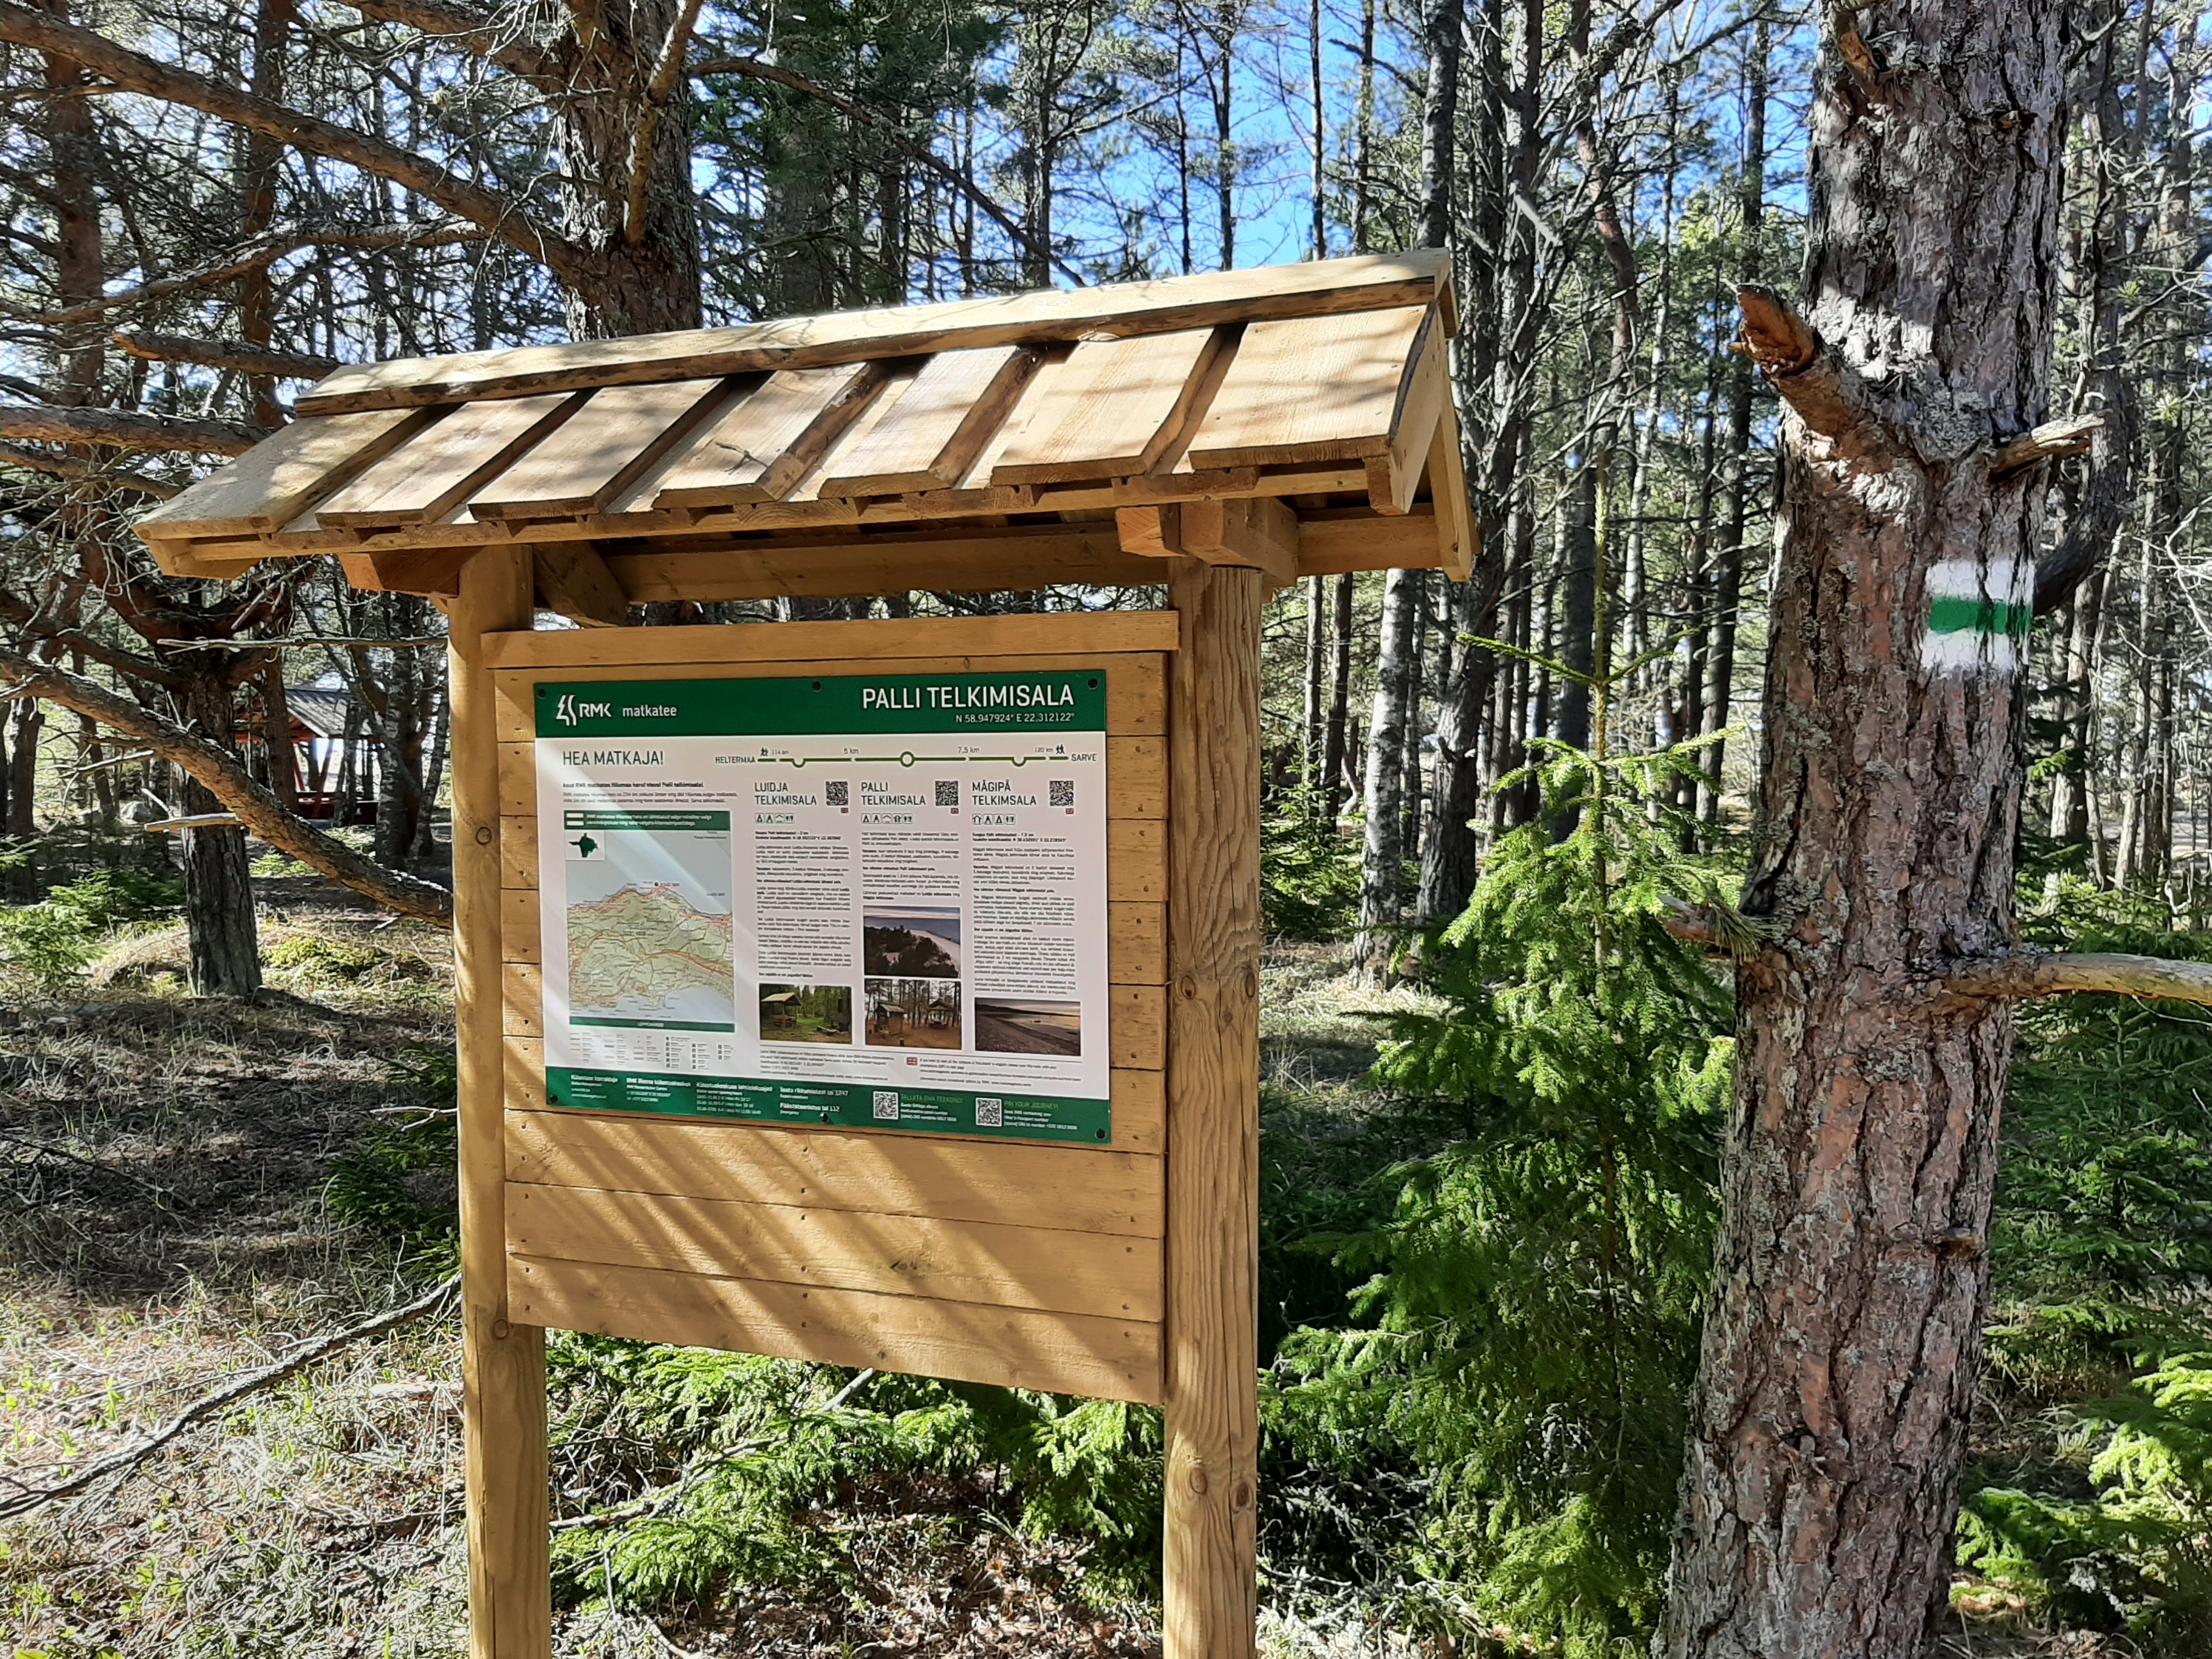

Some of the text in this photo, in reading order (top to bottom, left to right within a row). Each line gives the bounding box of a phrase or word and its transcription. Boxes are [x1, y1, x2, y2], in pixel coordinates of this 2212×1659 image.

[862, 684, 1074, 709] PALLI TELKIMISALA
[579, 703, 678, 717] RMK matkatee
[1016, 714, 1022, 722] E
[563, 750, 664, 765] HEA MATKAJA!
[754, 782, 788, 792] LUIDJA
[861, 782, 888, 792] PALLI
[754, 795, 817, 805] TELKIMISALA
[861, 795, 926, 805] TELKIMISALA
[972, 795, 1037, 805] TELKIMSALA
